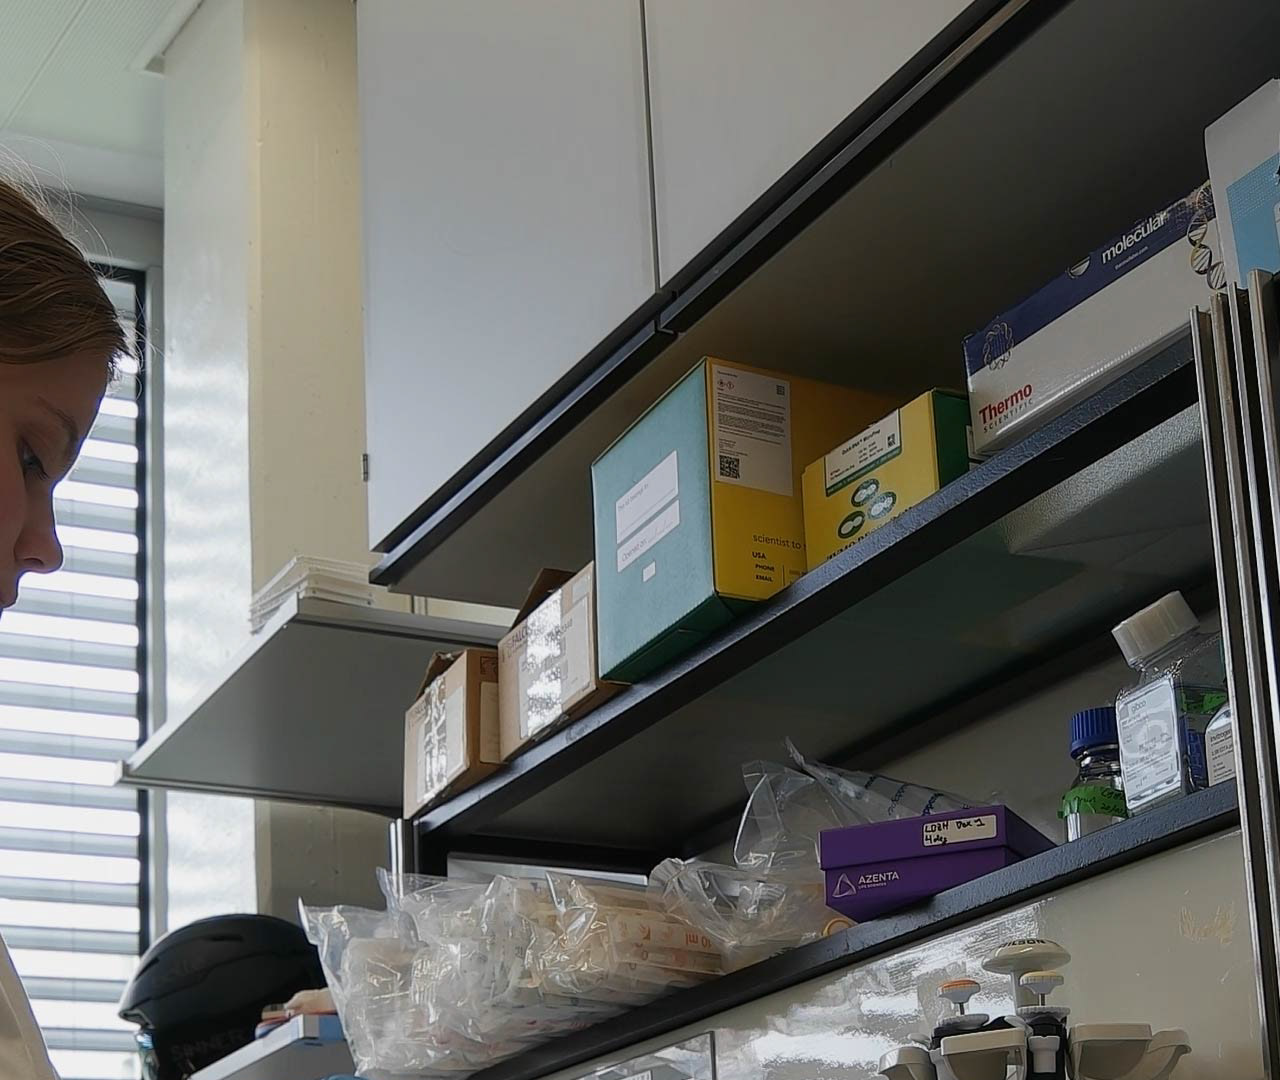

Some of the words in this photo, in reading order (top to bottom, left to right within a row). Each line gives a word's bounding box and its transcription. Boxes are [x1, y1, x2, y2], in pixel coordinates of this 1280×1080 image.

[1102, 211, 1167, 264] molecular
[979, 384, 1032, 424] Thermo
[984, 398, 1034, 433] SCIENTIFIC
[753, 534, 790, 548] scientist
[791, 540, 801, 550] to
[752, 552, 766, 560] USA
[858, 871, 900, 884] AZENTA
